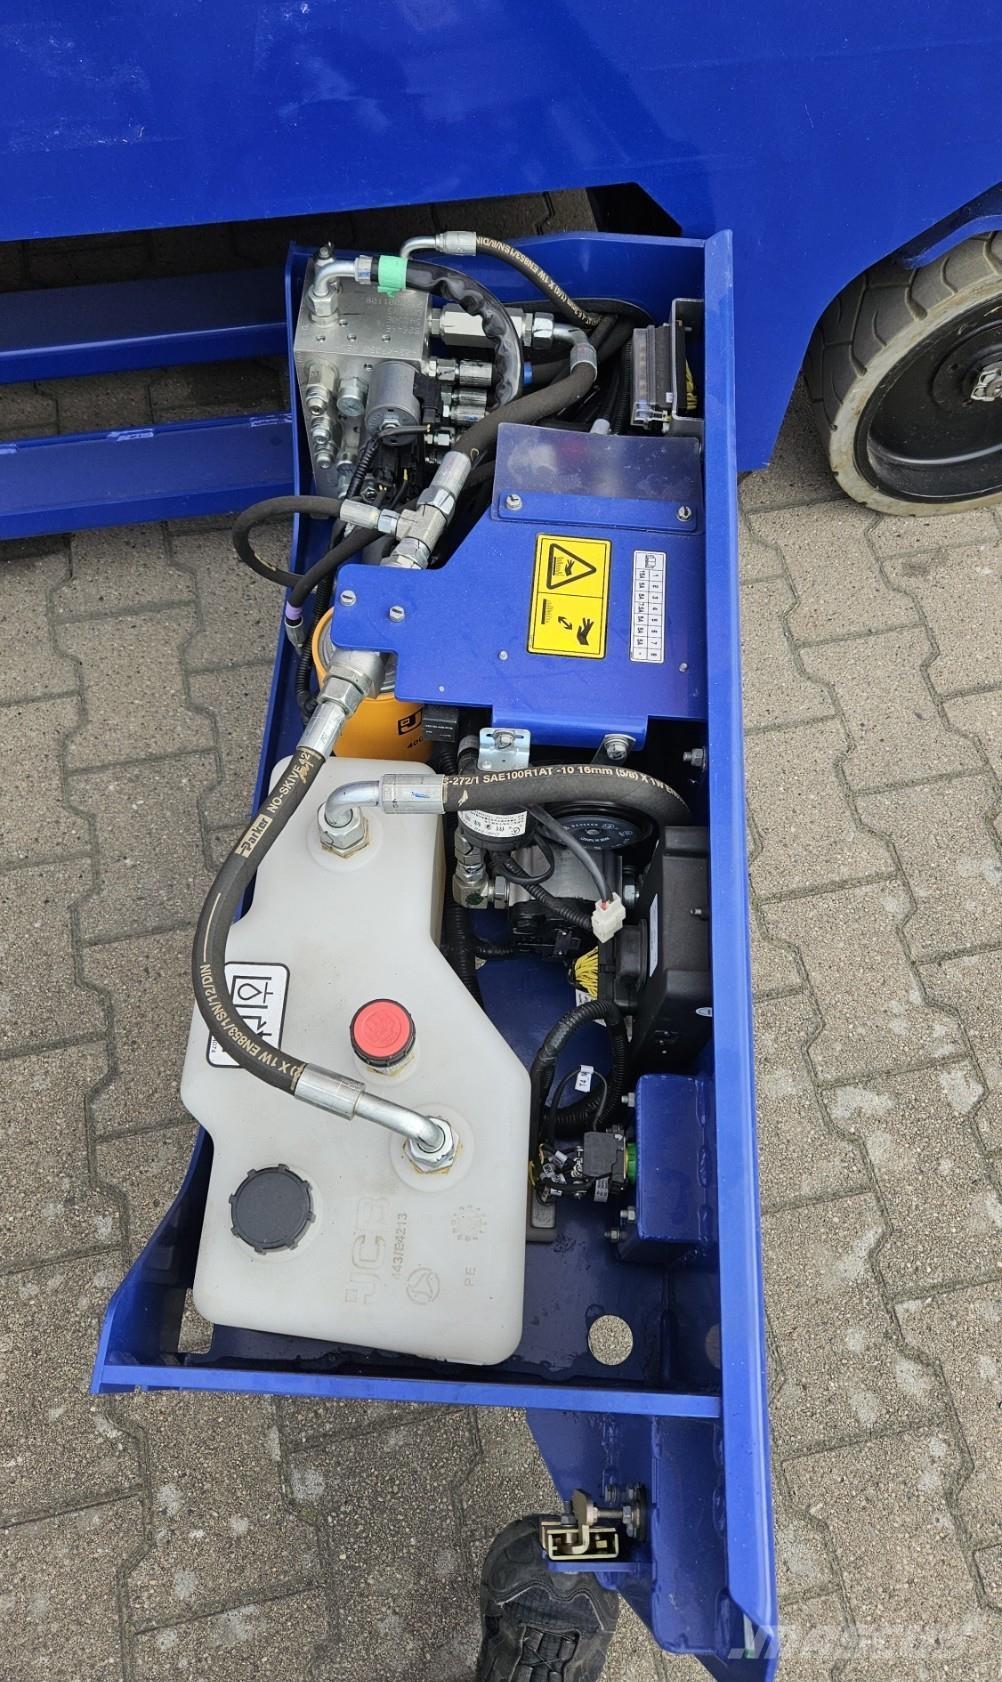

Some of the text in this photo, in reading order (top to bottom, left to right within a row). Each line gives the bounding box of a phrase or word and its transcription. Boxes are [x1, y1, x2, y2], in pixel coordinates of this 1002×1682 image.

[483, 768, 553, 783] SAE100R1AT
[556, 766, 574, 774] -10
[578, 766, 613, 776] 16mm
[616, 768, 638, 780] (5/8)
[640, 773, 648, 783] X
[240, 816, 270, 854] Parker
[266, 764, 301, 814] NO-SKIVE
[200, 964, 260, 1055] EN853/1SN/12/DIN
[259, 1052, 278, 1067] 1W
[279, 1061, 291, 1073] X
